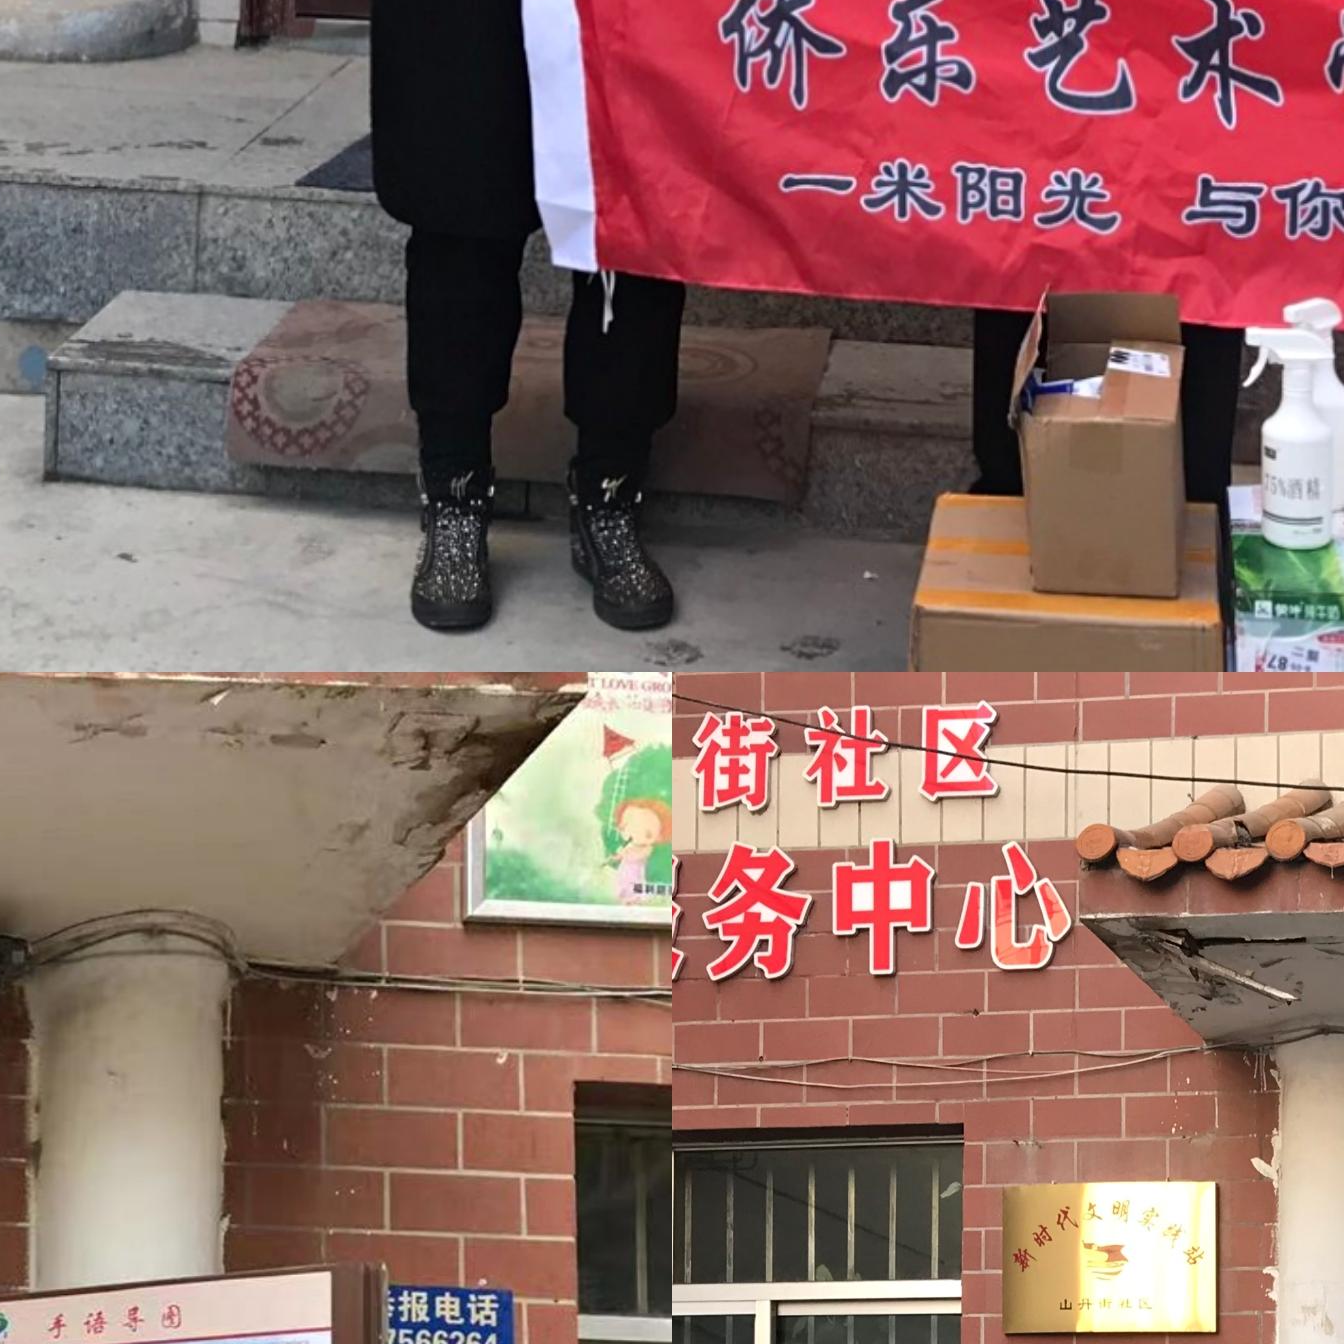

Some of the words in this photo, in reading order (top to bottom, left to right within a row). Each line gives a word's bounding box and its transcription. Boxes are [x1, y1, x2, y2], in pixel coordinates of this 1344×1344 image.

[779, 159, 1123, 235] 一米阳光
[692, 700, 1000, 812] 街社区
[633, 883, 672, 895] 福利路
[672, 838, 1072, 981] 务中心
[1011, 1199, 1205, 1273] 新时代文明实践站
[47, 1304, 184, 1340] 手语导图
